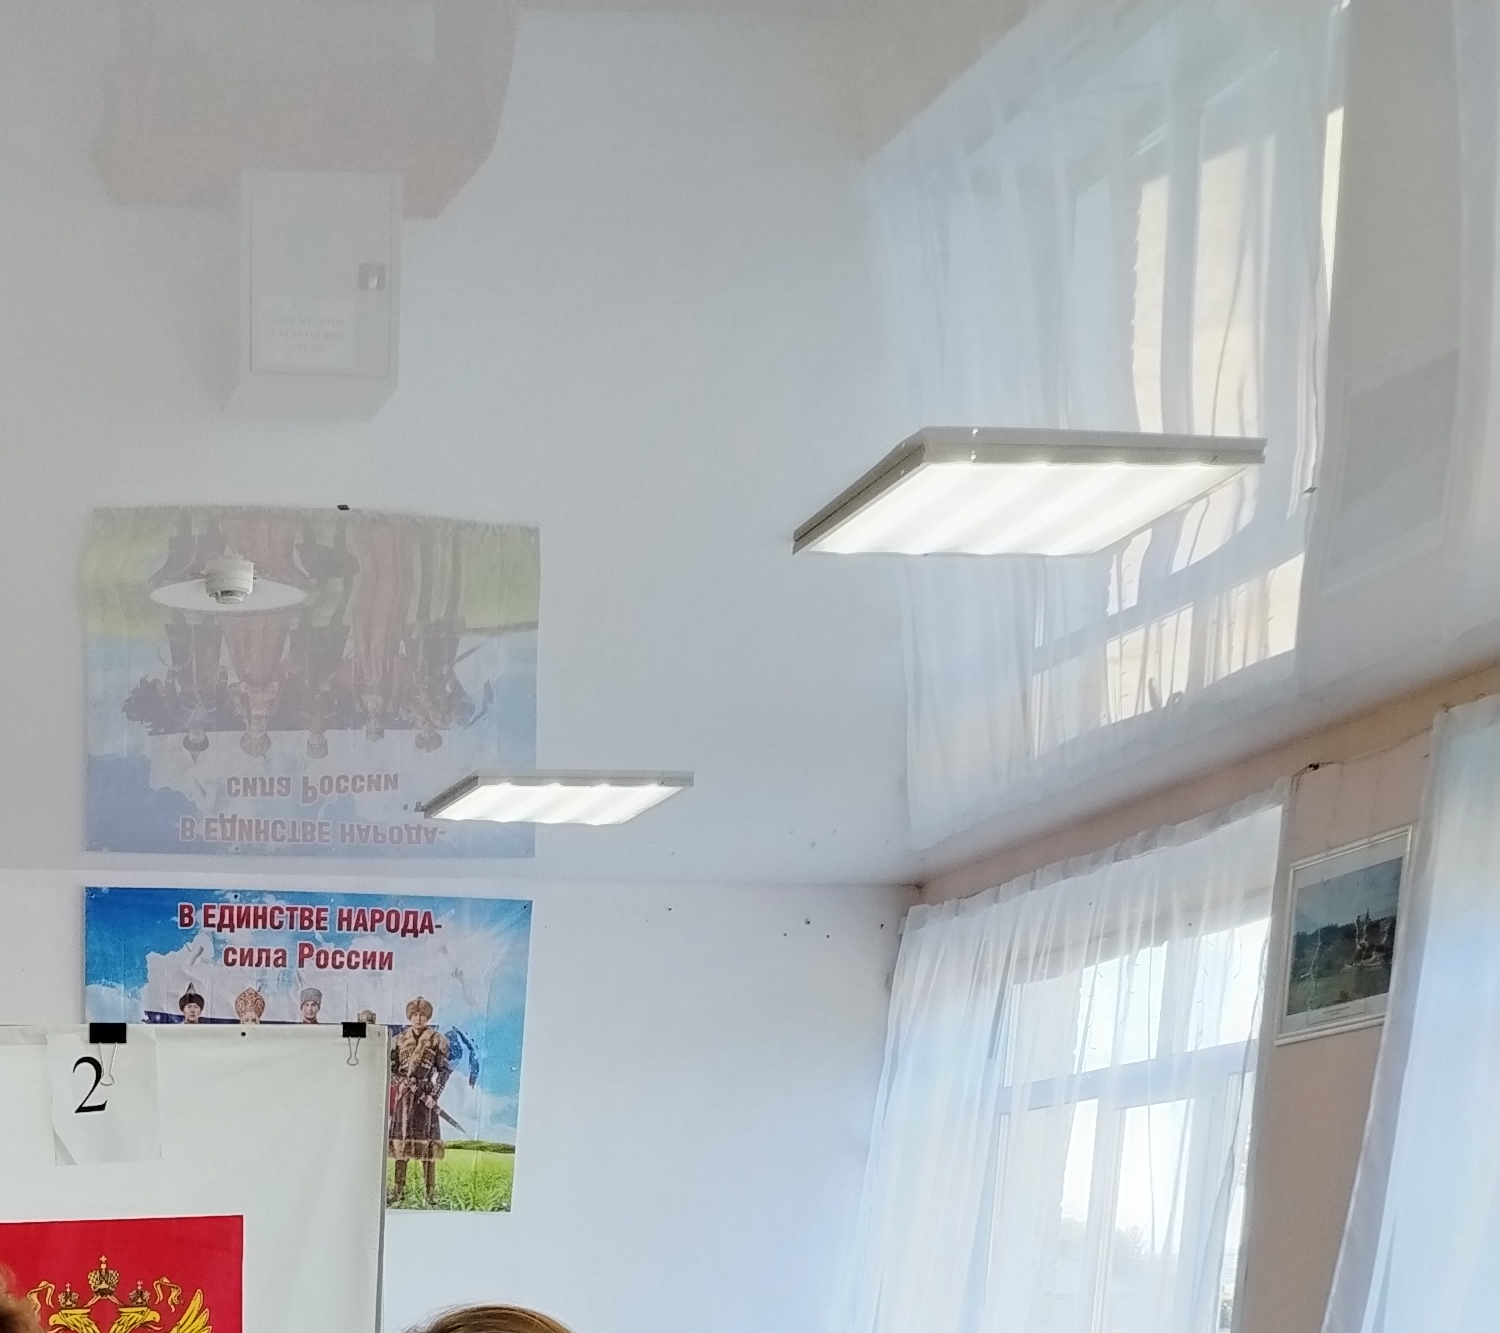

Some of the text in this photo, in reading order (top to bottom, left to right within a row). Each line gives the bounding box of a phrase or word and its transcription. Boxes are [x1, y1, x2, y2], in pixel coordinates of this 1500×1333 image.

[178, 904, 443, 938] В ЕДИНСТВЕ НАРОДА-
[223, 942, 394, 971] сила России
[72, 1056, 108, 1113] 2
